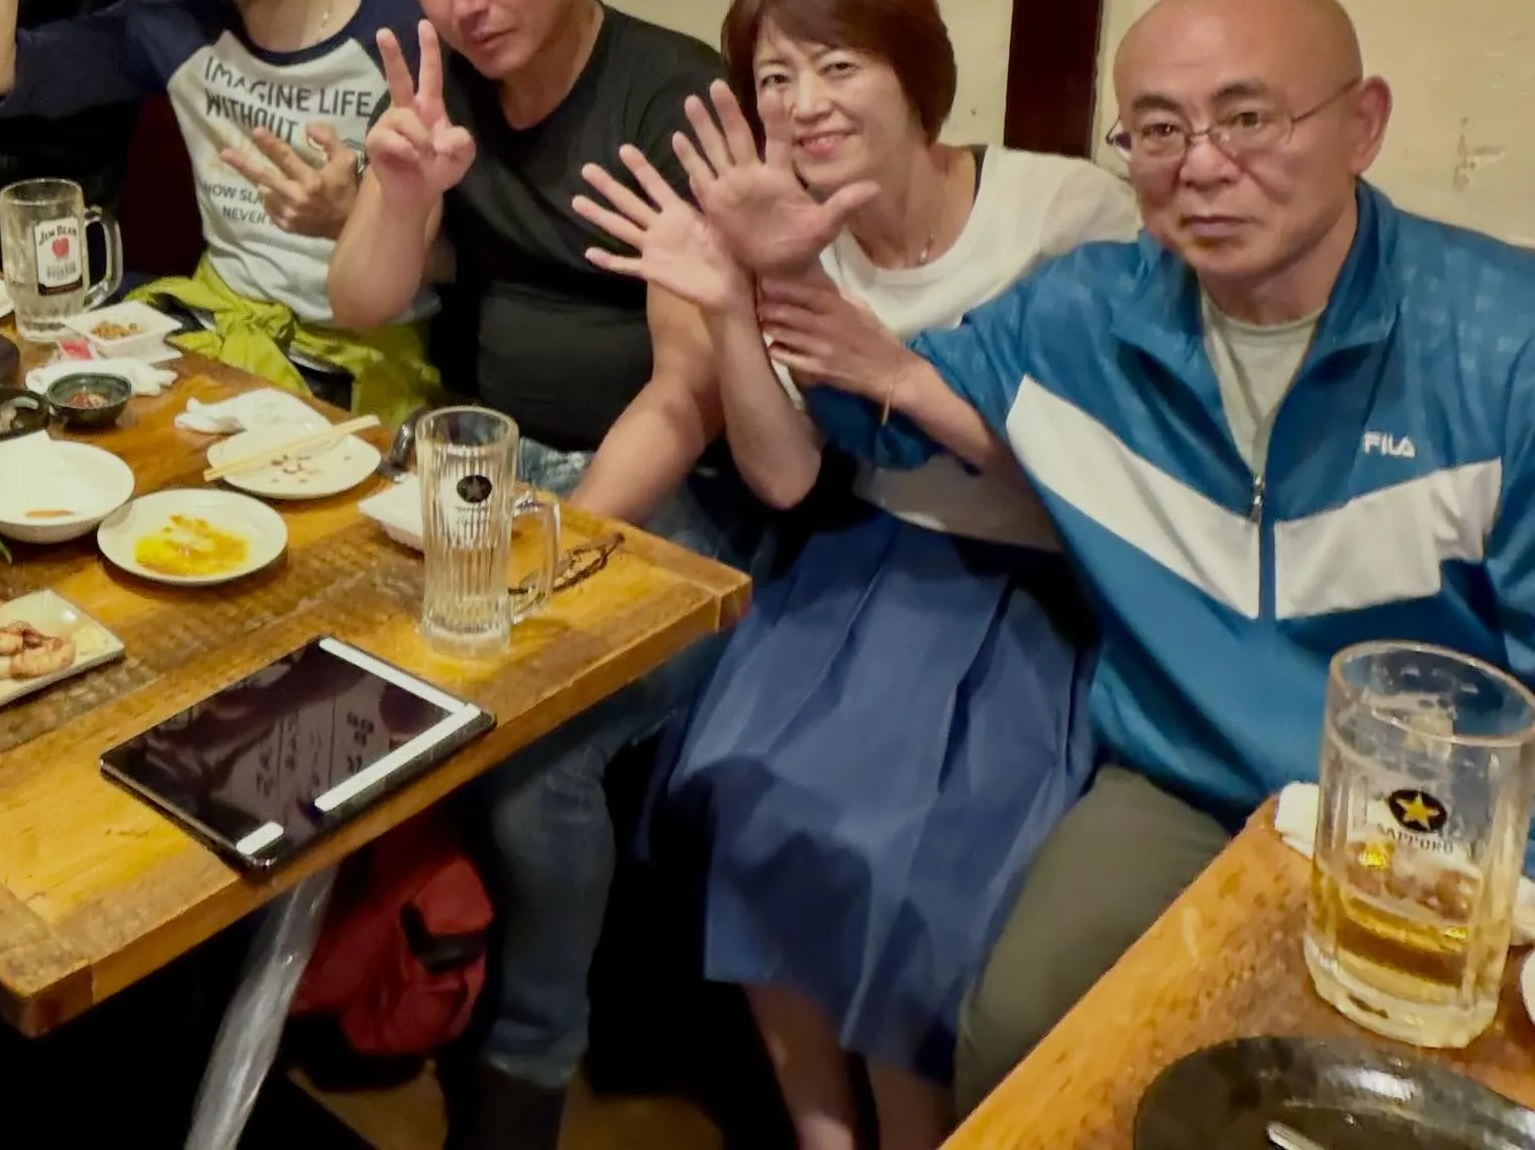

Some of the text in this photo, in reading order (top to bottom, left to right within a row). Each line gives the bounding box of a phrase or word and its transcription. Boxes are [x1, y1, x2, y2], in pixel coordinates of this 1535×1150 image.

[204, 56, 372, 118] IMAGINE LIFE
[204, 87, 299, 145] WITHOUT
[1364, 431, 1416, 458] FILA
